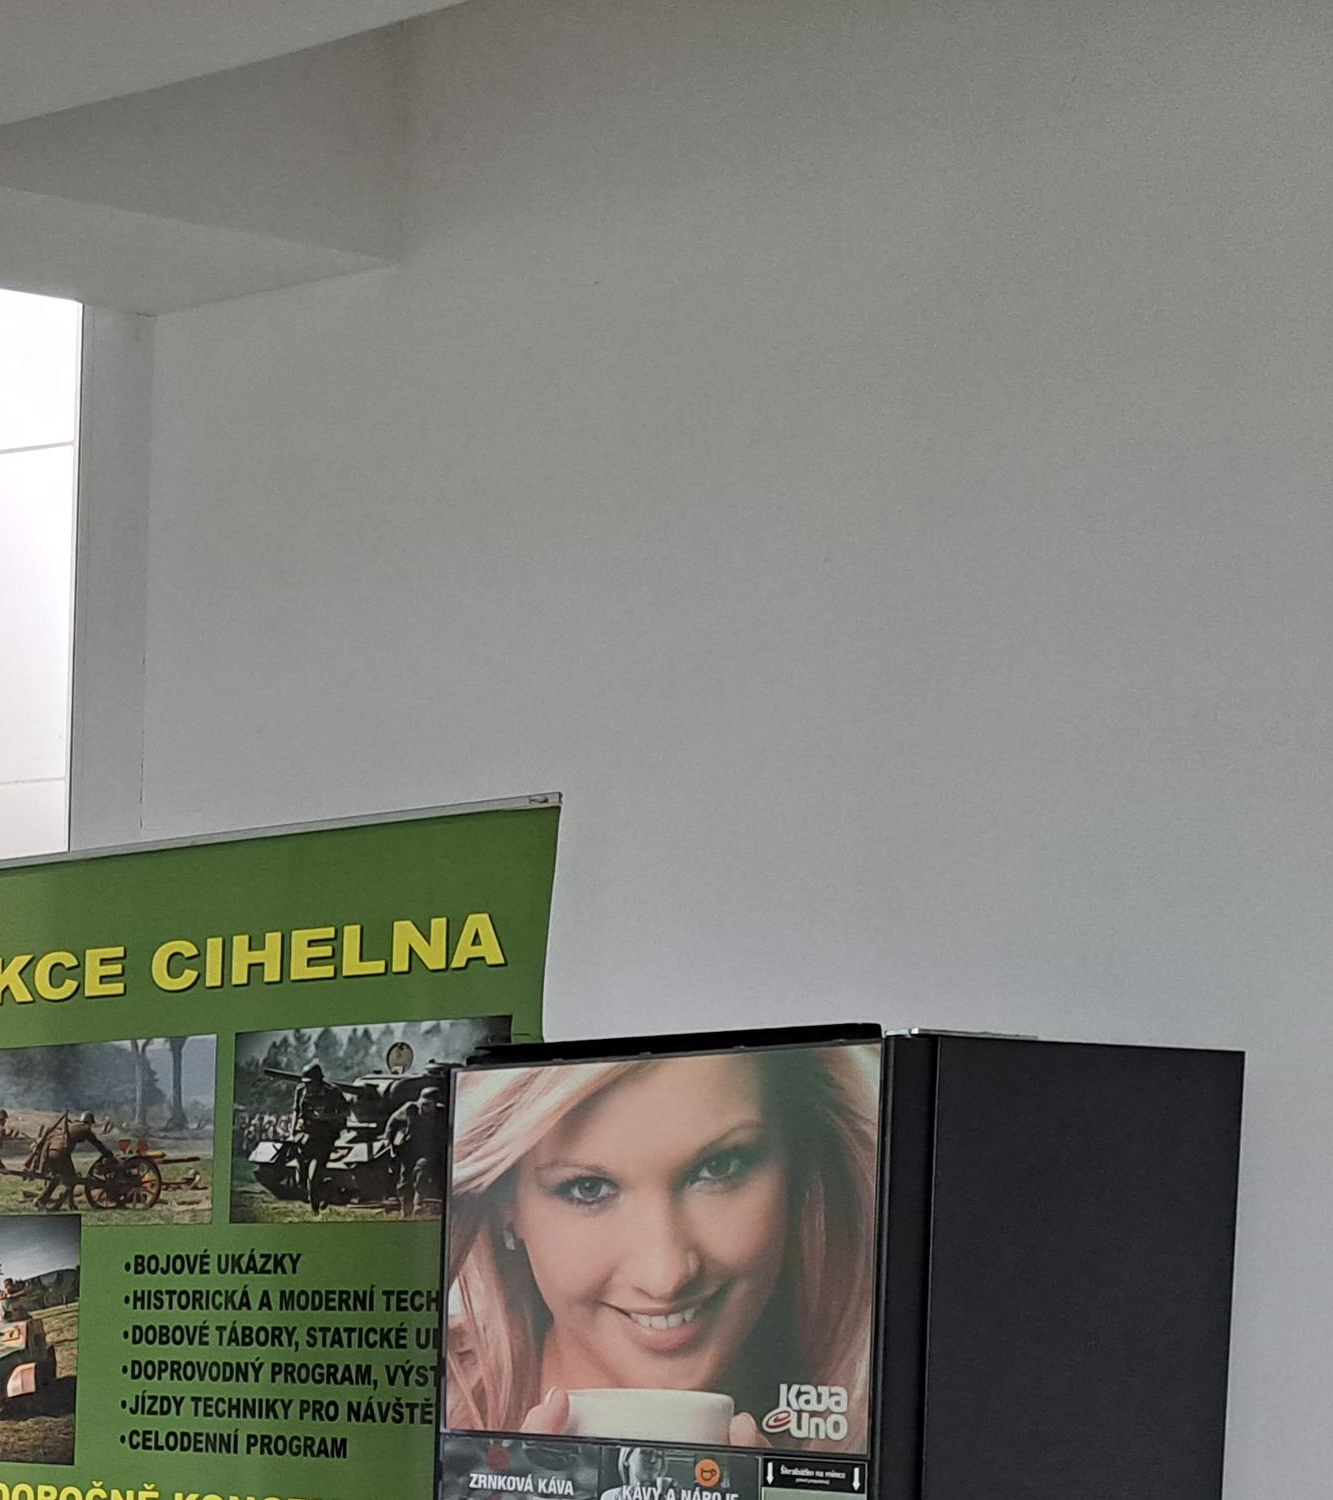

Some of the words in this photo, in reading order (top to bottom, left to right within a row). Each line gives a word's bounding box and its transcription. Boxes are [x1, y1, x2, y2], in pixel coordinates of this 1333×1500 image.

[149, 911, 508, 994] CIHELNA
[133, 1250, 211, 1275] BOJOVÉ
[216, 1249, 302, 1275] UKÁZKY
[132, 1285, 252, 1312] HISTORICKÁ
[258, 1290, 273, 1312] A
[279, 1285, 376, 1312] MODERNÍ
[131, 1321, 210, 1346] DOBOVÉ
[215, 1321, 300, 1352] TÁBORY,
[305, 1322, 408, 1350] STATICKÉ
[130, 1357, 265, 1383] DOPROVODNÝ
[270, 1362, 379, 1391] PROGRAM,
[128, 1390, 185, 1416] JÍZDY
[190, 1397, 294, 1420] TECHNIKY
[298, 1400, 340, 1422] PRO
[128, 1429, 239, 1454] CELODENNÍ
[245, 1434, 348, 1459] PROGRAM
[469, 1473, 533, 1492] ZRNKOVÁ
[537, 1476, 575, 1496] KÁVA
